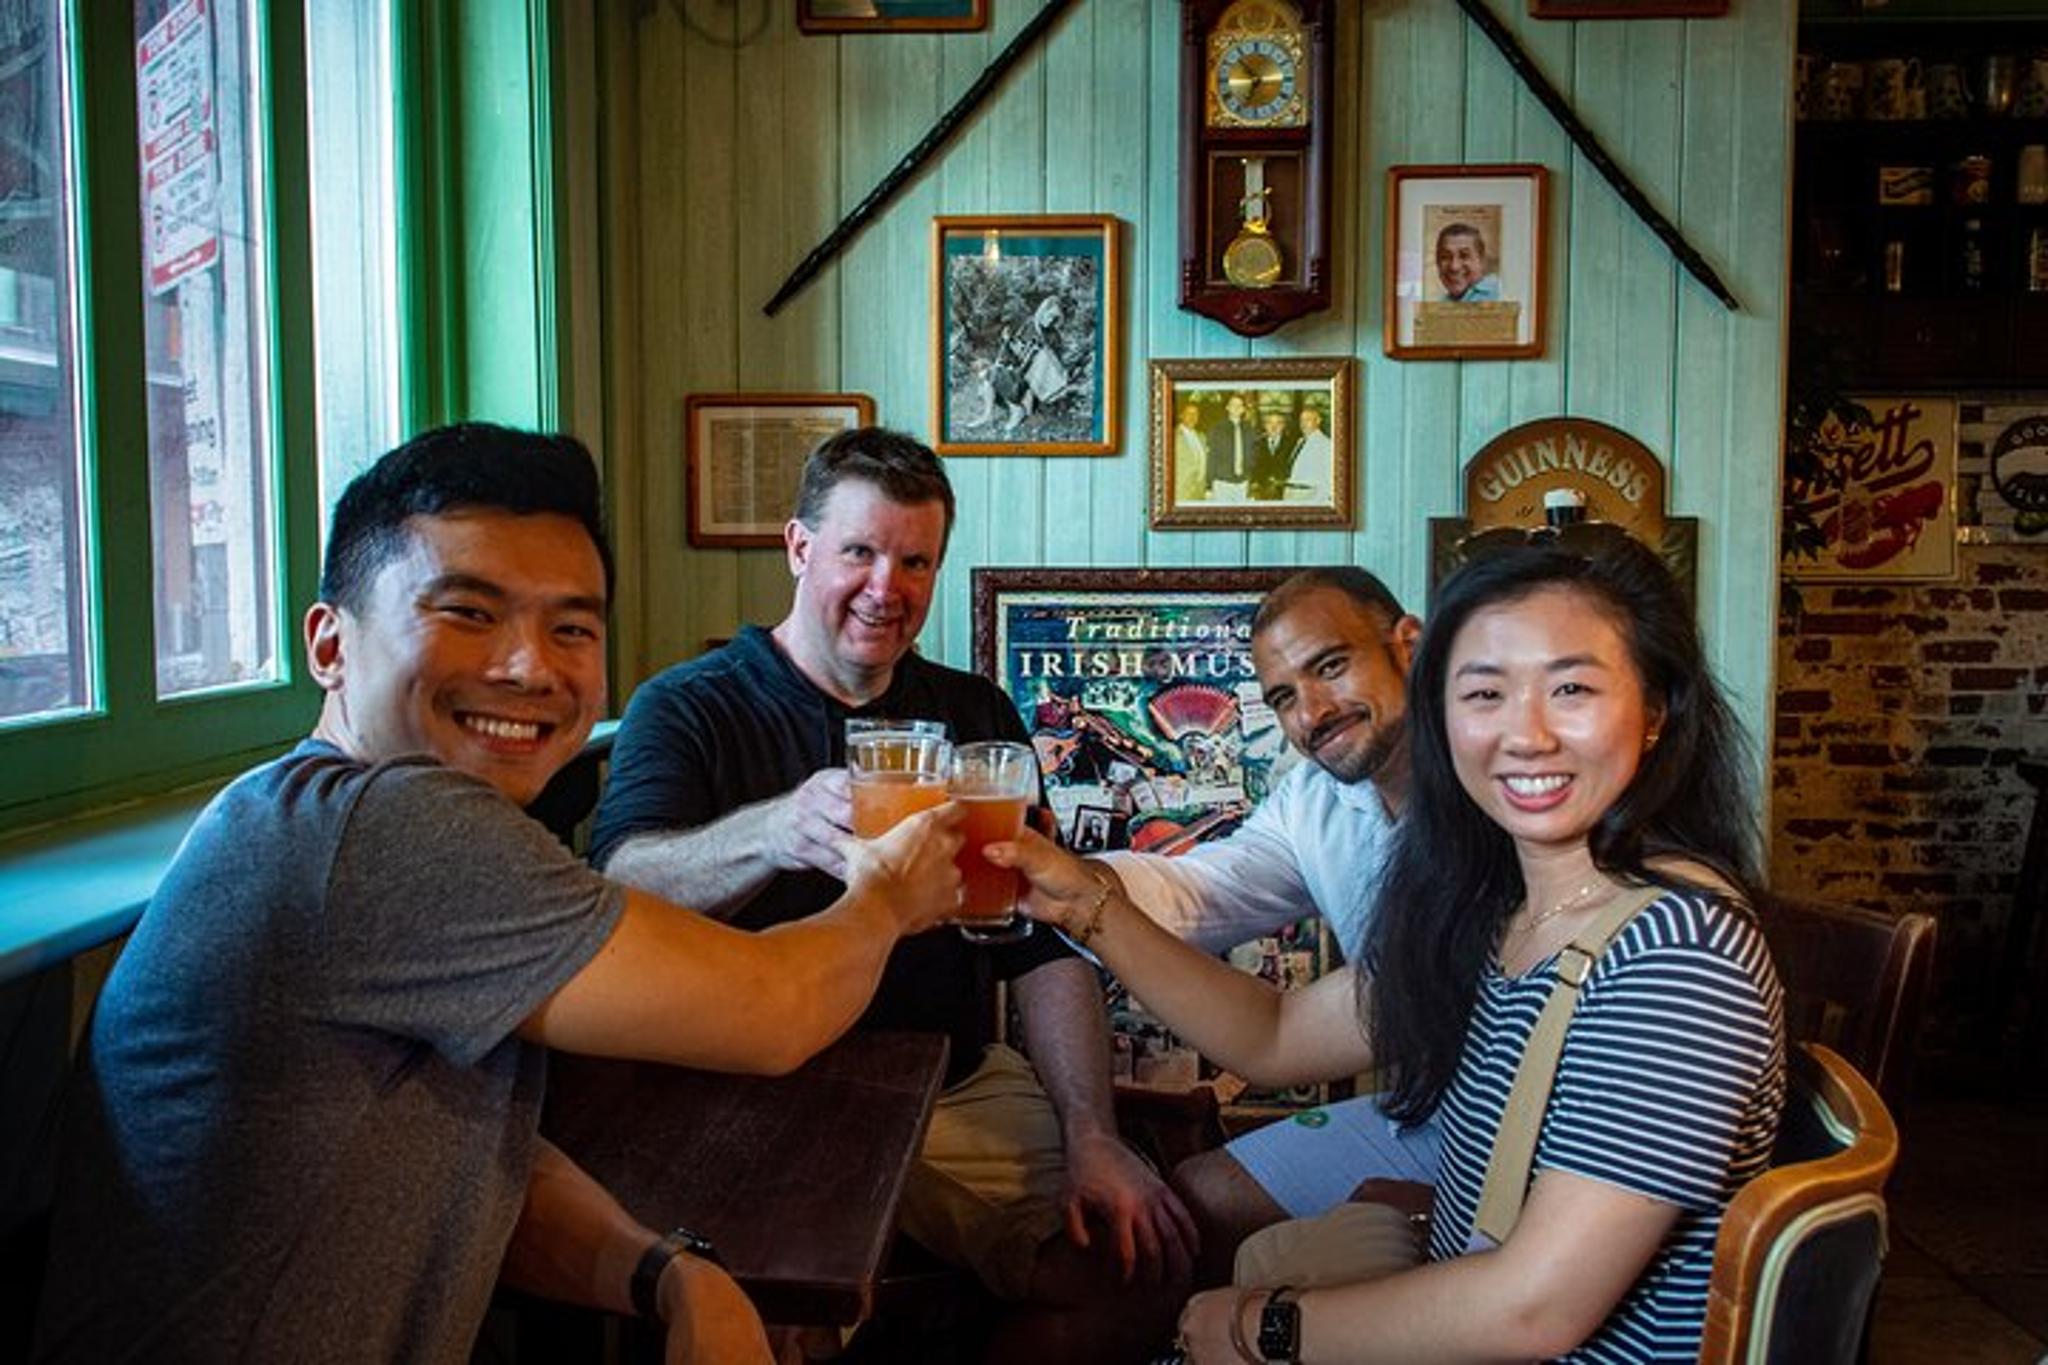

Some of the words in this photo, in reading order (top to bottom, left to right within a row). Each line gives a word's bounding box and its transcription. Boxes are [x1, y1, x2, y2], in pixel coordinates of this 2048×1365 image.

[1477, 432, 1650, 503] GUINNESS
[1066, 615, 1252, 639] Traditiona
[1020, 651, 1144, 678] IRISH
[1168, 650, 1255, 681] MUS
